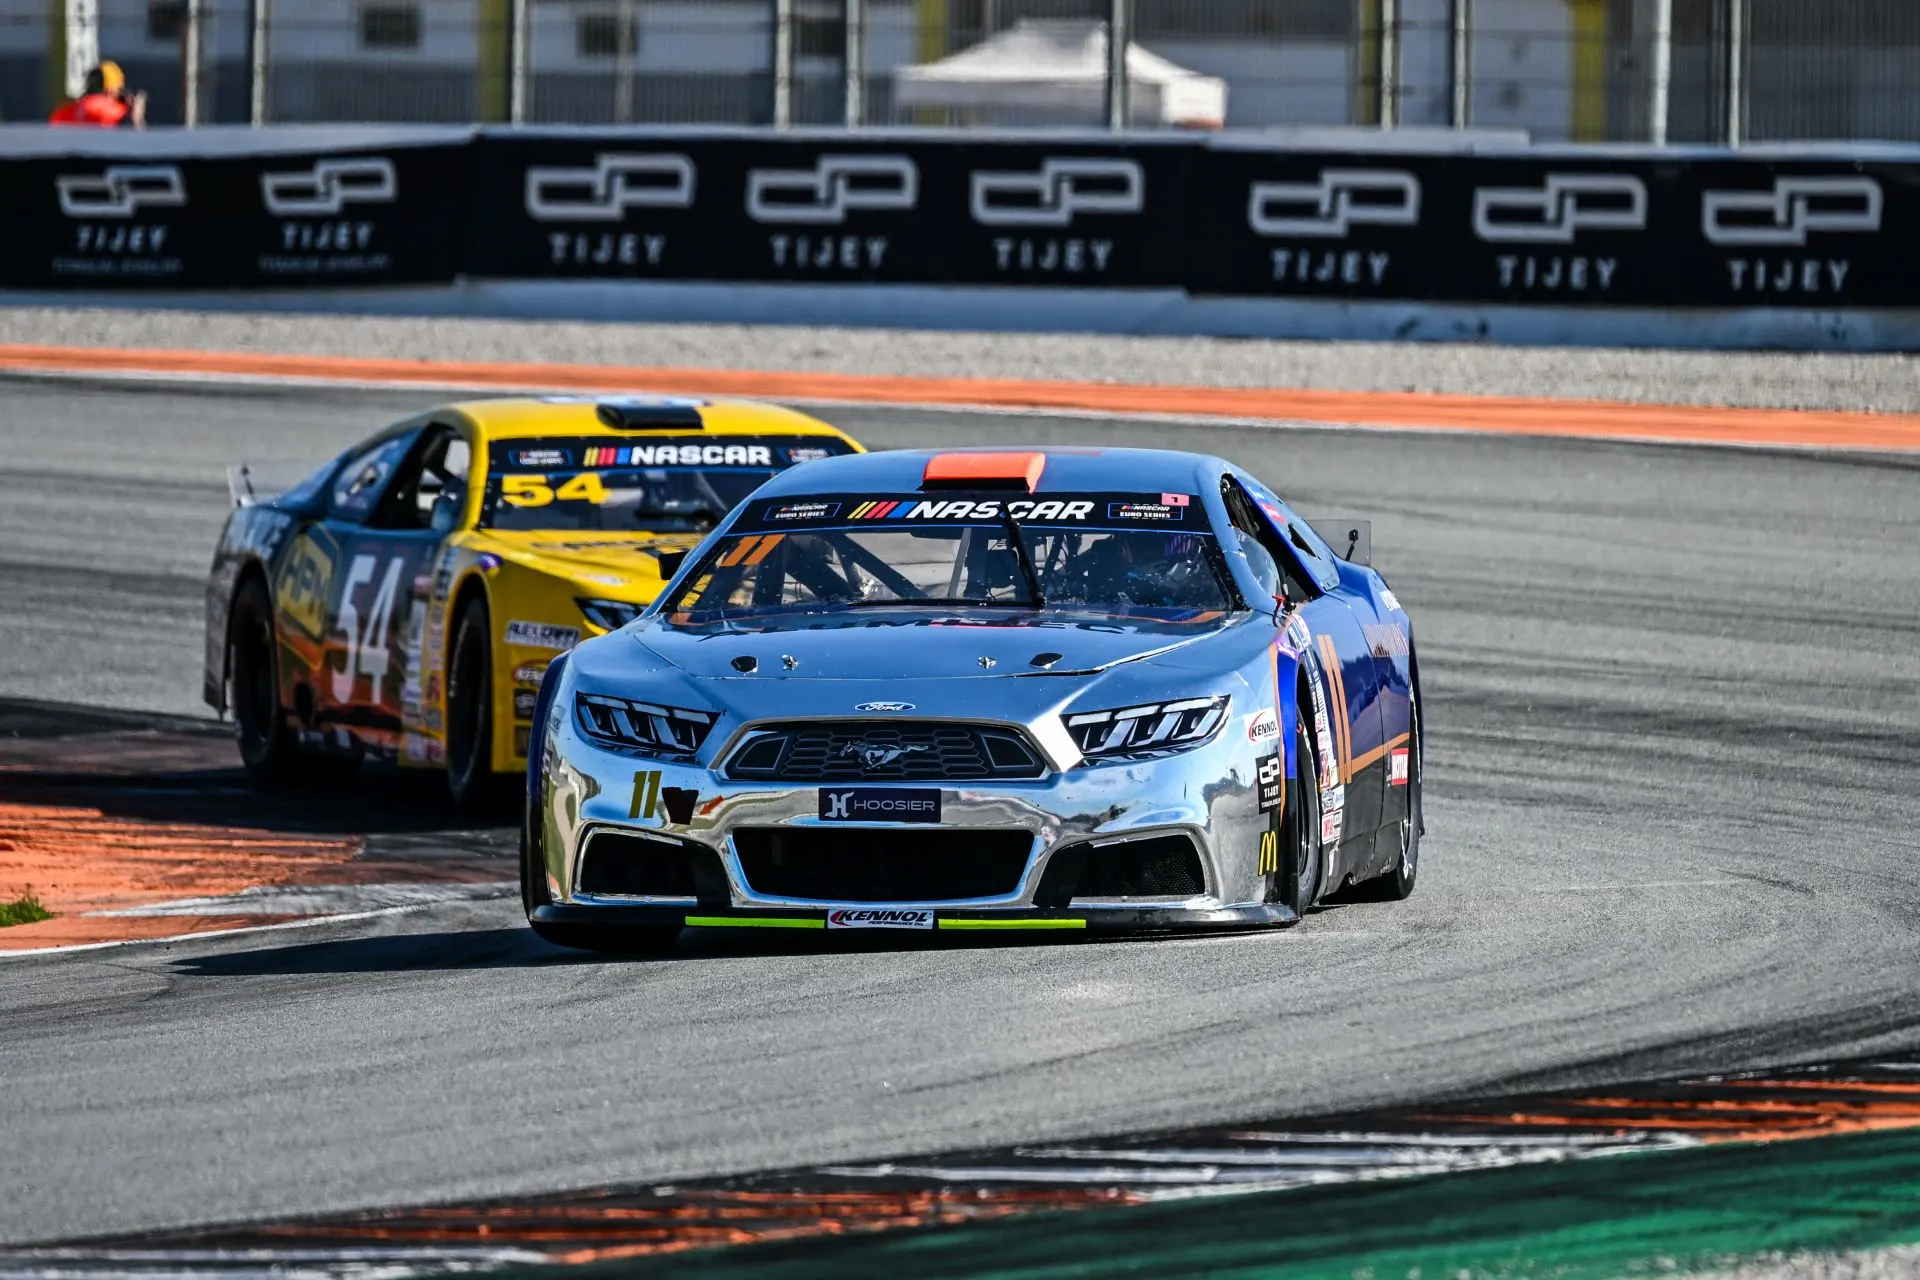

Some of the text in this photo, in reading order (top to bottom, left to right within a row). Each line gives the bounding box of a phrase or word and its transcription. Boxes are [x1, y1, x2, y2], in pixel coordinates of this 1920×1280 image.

[77, 225, 166, 252] TIJEY
[281, 222, 373, 249] TIJEY
[549, 233, 665, 265] TIJEY
[770, 236, 888, 268] TIJEY
[994, 238, 1112, 271] TIJEY
[1270, 250, 1389, 285] TIJEY
[1498, 255, 1617, 290] TIJEY
[1726, 259, 1849, 292] TIJEY
[630, 445, 771, 466] NASCAR
[502, 472, 613, 507] 54
[906, 501, 1095, 520] NASCAR
[720, 534, 786, 567] 11
[334, 554, 405, 704] 54
[629, 771, 662, 818] 11
[854, 799, 935, 812] HOOSIER
[1263, 784, 1280, 799] TIJEY
[839, 910, 928, 922] KENNOL
